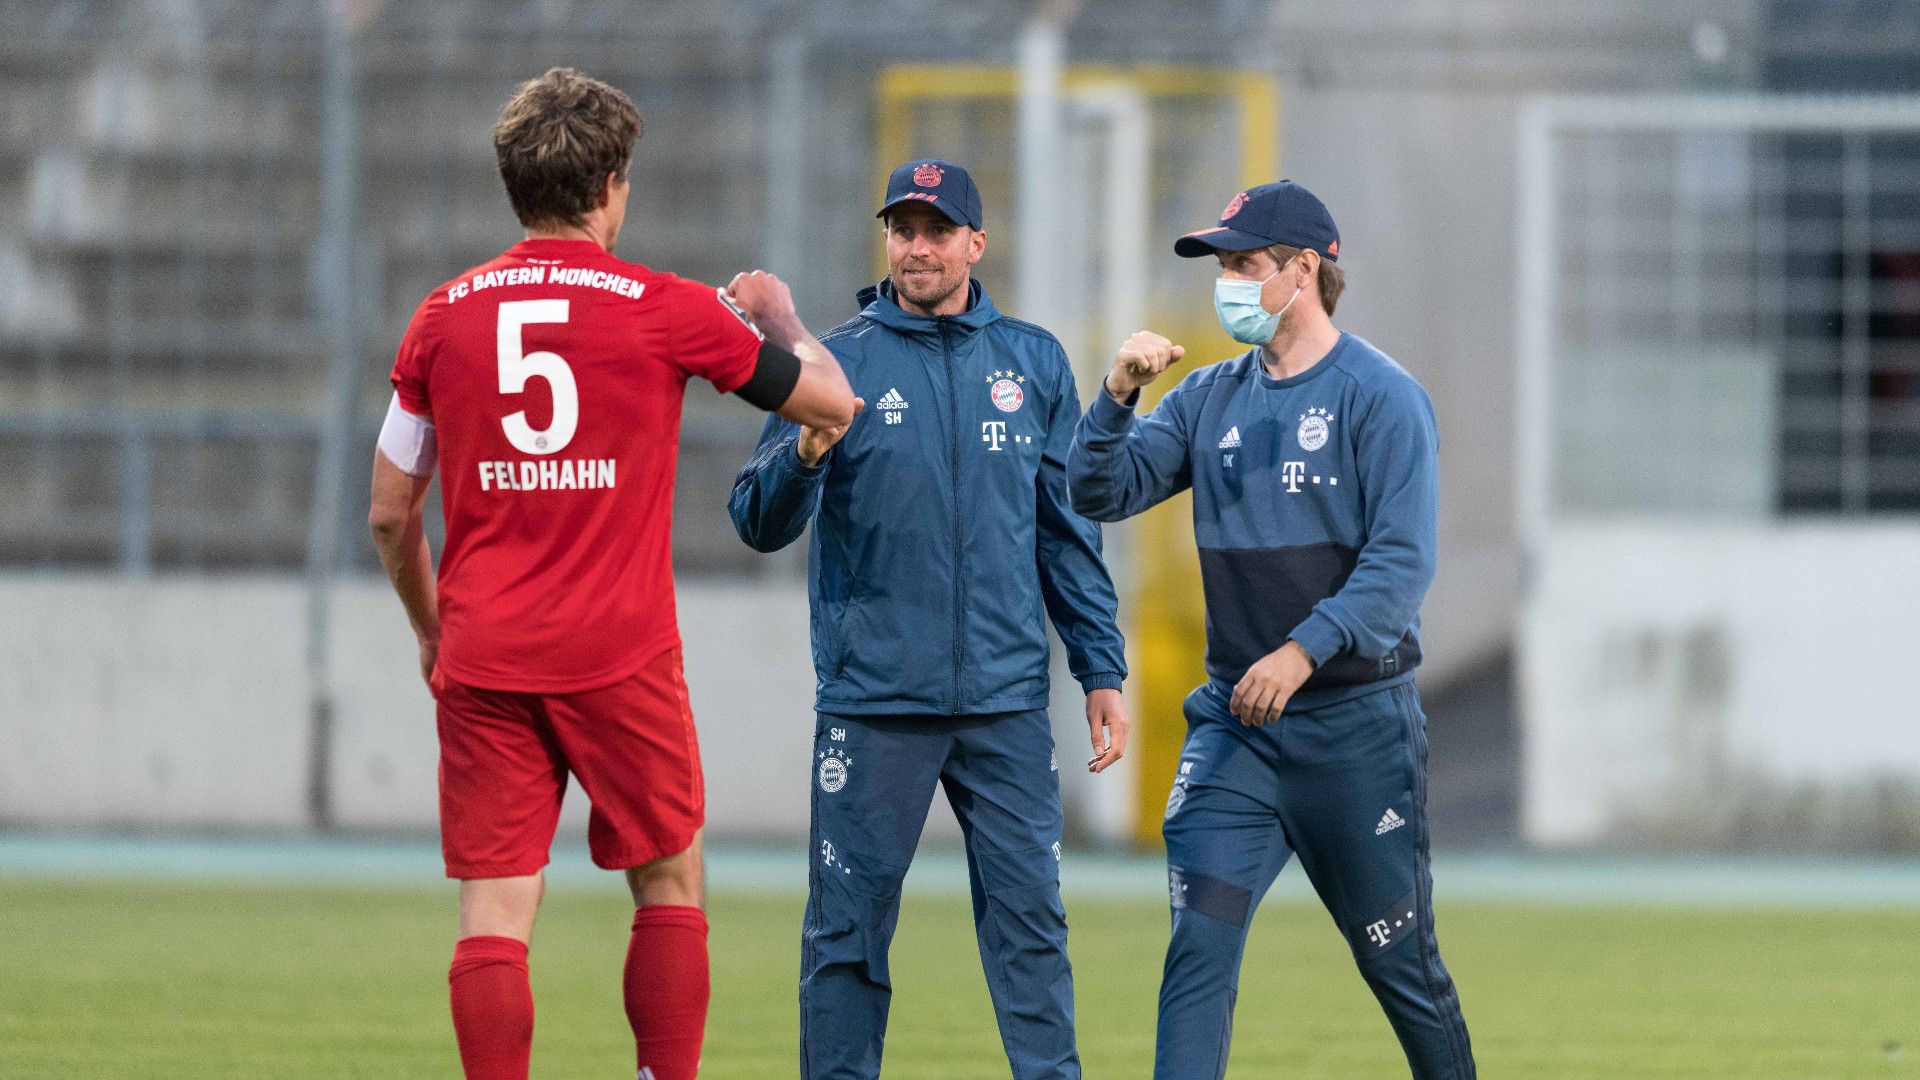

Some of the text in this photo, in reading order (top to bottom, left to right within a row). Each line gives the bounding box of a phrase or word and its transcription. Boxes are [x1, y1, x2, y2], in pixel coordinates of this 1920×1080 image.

[447, 281, 470, 304] FC
[472, 266, 545, 292] BAYERN
[497, 299, 579, 455] 5
[876, 401, 909, 410] adidas
[884, 411, 902, 425] SH
[478, 459, 616, 492] FELDHAHN
[830, 727, 846, 742] SH
[1375, 817, 1406, 836] adidas
